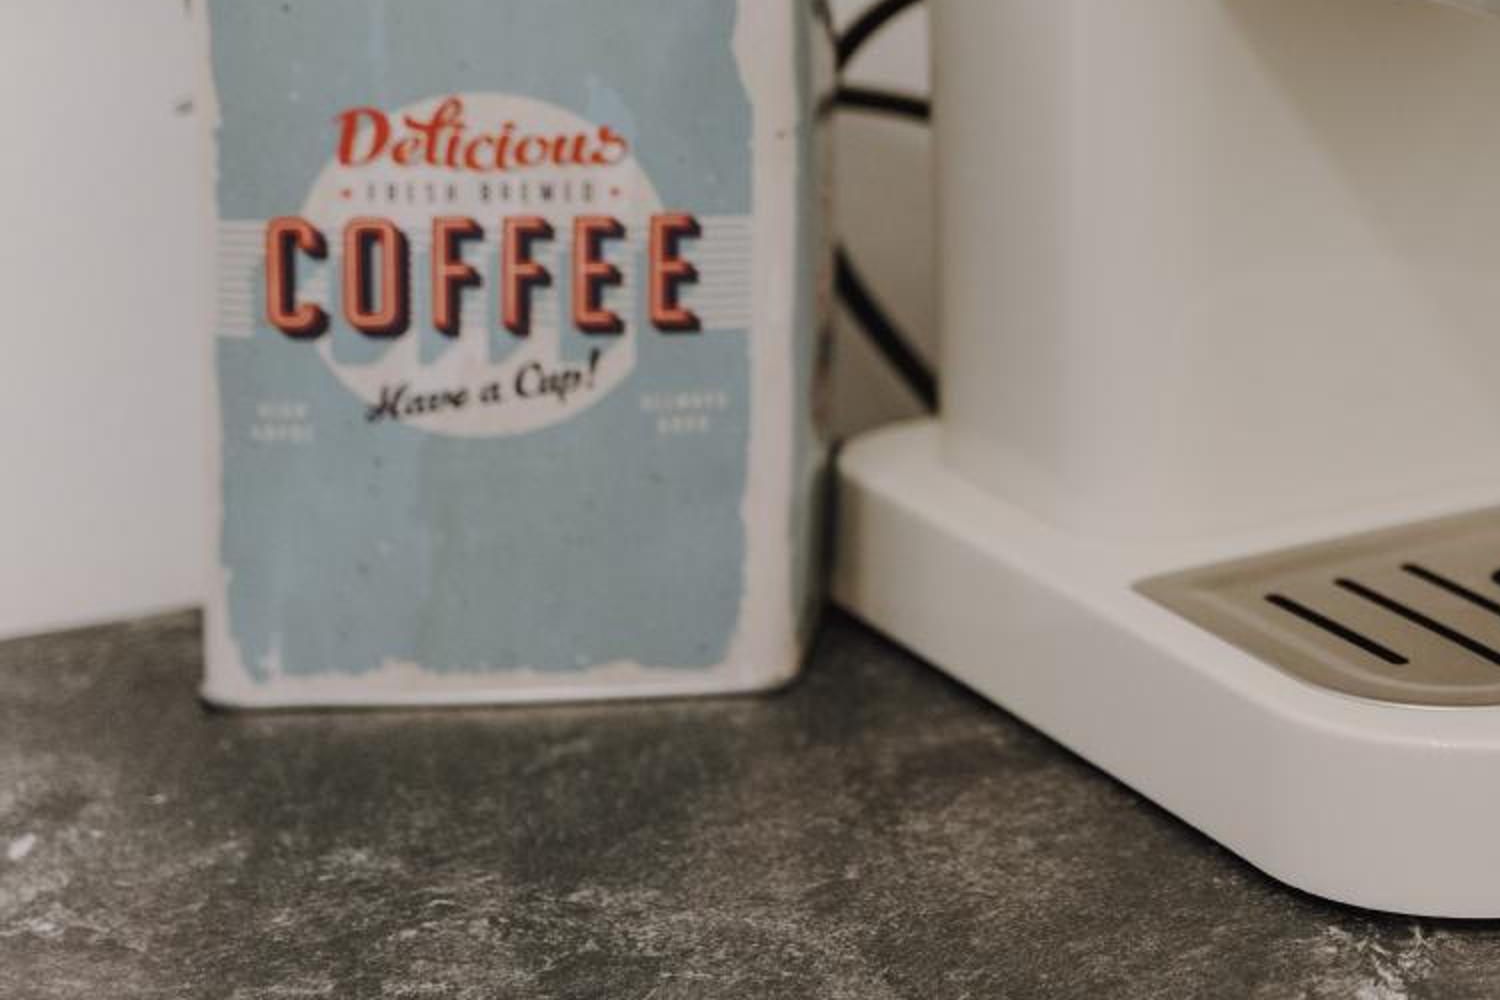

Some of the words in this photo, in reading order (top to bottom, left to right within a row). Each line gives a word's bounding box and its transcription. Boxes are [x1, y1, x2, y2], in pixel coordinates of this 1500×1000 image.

[333, 97, 628, 173] Delicious
[264, 213, 703, 342] COFFEE
[364, 383, 468, 424] Have
[479, 383, 502, 404] a
[514, 348, 602, 402] Cup!
